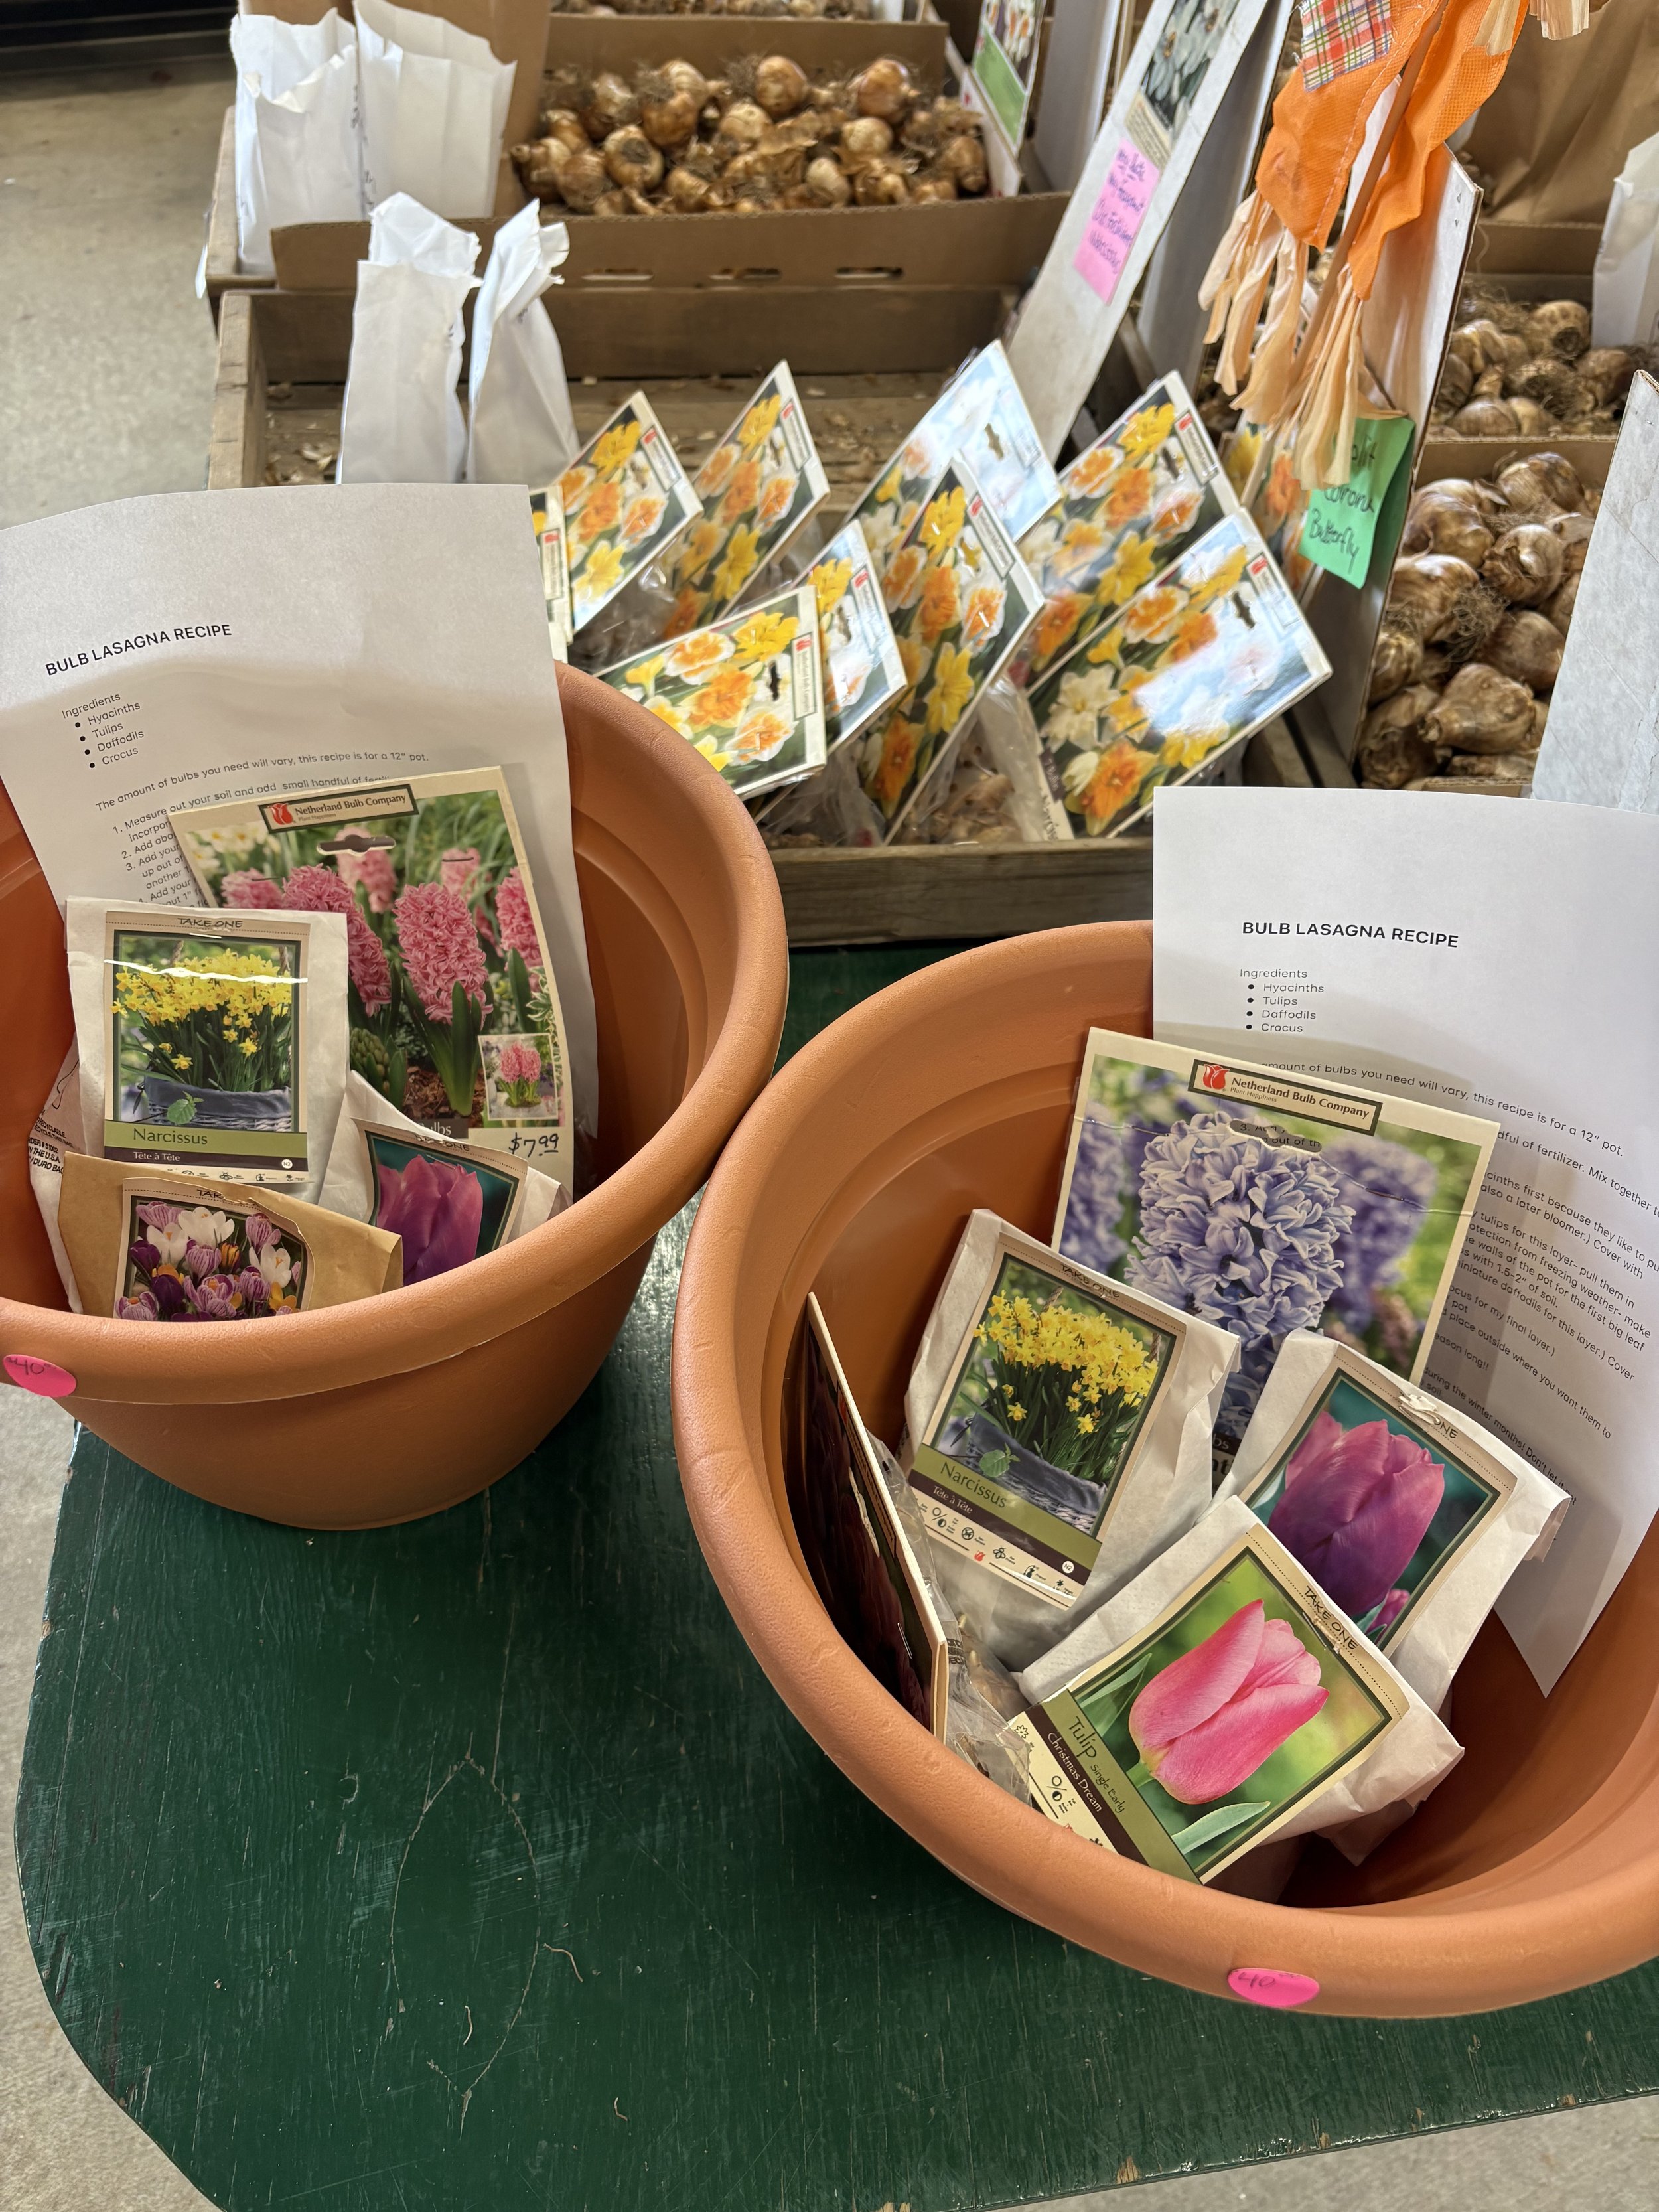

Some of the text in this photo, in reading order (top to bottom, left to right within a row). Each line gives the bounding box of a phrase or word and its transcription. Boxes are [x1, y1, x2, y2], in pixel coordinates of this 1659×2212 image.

[1309, 508, 1360, 575] Butterfly
[46, 625, 232, 676] BULB LASAGNA RECIPE
[62, 693, 121, 719] Ingredients
[88, 701, 141, 725] Hyacinths
[92, 722, 123, 739] Tulips
[97, 730, 145, 752] Daffodils
[102, 747, 139, 765] Crocus
[96, 800, 115, 812] The
[117, 784, 155, 803] amount
[158, 779, 168, 788] of
[171, 772, 199, 785] bulbs
[201, 767, 221, 778] you
[224, 761, 250, 773] need
[252, 759, 269, 768] will
[271, 757, 296, 767] vary,
[299, 755, 317, 763] this
[321, 753, 351, 762] recipe
[354, 751, 362, 760] is
[365, 751, 378, 760] for
[409, 753, 429, 762] pot.
[113, 826, 123, 834] 1.
[125, 808, 167, 830] Measure
[170, 802, 186, 813] out
[188, 796, 211, 809] your
[214, 790, 232, 800] soil
[234, 787, 254, 797] and
[257, 784, 277, 794] add
[283, 780, 309, 790] small
[312, 776, 350, 787] handful
[295, 794, 407, 816] Netherland Bulb Company
[135, 839, 153, 854] Add
[139, 851, 157, 866] Add
[159, 844, 180, 858] your
[142, 860, 172, 879] up out
[146, 869, 182, 889] another
[150, 879, 191, 901] Add your
[178, 917, 244, 928] TAKE ONE
[1242, 922, 1459, 948] BULB LASAGNA RECIPE
[1240, 968, 1307, 979] Ingredients
[1263, 983, 1324, 993] Hyacinths
[1263, 996, 1298, 1005] Tulips
[1262, 1009, 1316, 1019] Daffodils
[1261, 1023, 1303, 1033] Crocus
[1230, 1087, 1277, 1103] Plant Happiness
[1232, 1077, 1370, 1119] Netherland Bulb Company
[1309, 1063, 1623, 1157] of bulbs you need will vary, this recipe is pot.
[133, 1128, 208, 1145] Narcissus
[444, 1142, 470, 1151] ONE
[33, 1148, 44, 1157] THE
[33, 1158, 52, 1169] DURO
[133, 1151, 152, 1161] Tête
[161, 1153, 180, 1161] Tête
[1537, 1143, 1652, 1211] fertilizer. Mix together
[1480, 1184, 1644, 1280] also later bloomer.) Cover with
[1523, 1185, 1634, 1254] first because they like
[1480, 1213, 1624, 1303] tulips this layer- pull them
[1060, 1264, 1120, 1298] TAKE ONE
[1473, 1250, 1558, 1308] with soil.
[1514, 1246, 1652, 1338] from freezing weather- make
[1451, 1299, 1468, 1313] pot
[1478, 1241, 1645, 1352] walls the pot the first big leaf
[1490, 1306, 1556, 1357] my final layer.)
[1500, 1282, 1635, 1380] daffodils this layer.) Cover
[1449, 1313, 1601, 1431] place outside where you want them
[1452, 1384, 1527, 1451] the winter months!
[940, 1461, 1007, 1509] Narcissus
[933, 1485, 950, 1501] Tête
[956, 1497, 974, 1514] Tête
[1304, 1585, 1358, 1649] TAKE ONE
[1047, 1732, 1081, 1780] Christmas
[1078, 1778, 1103, 1812] Dream
[1068, 1716, 1126, 1814] Tulip Single Early
